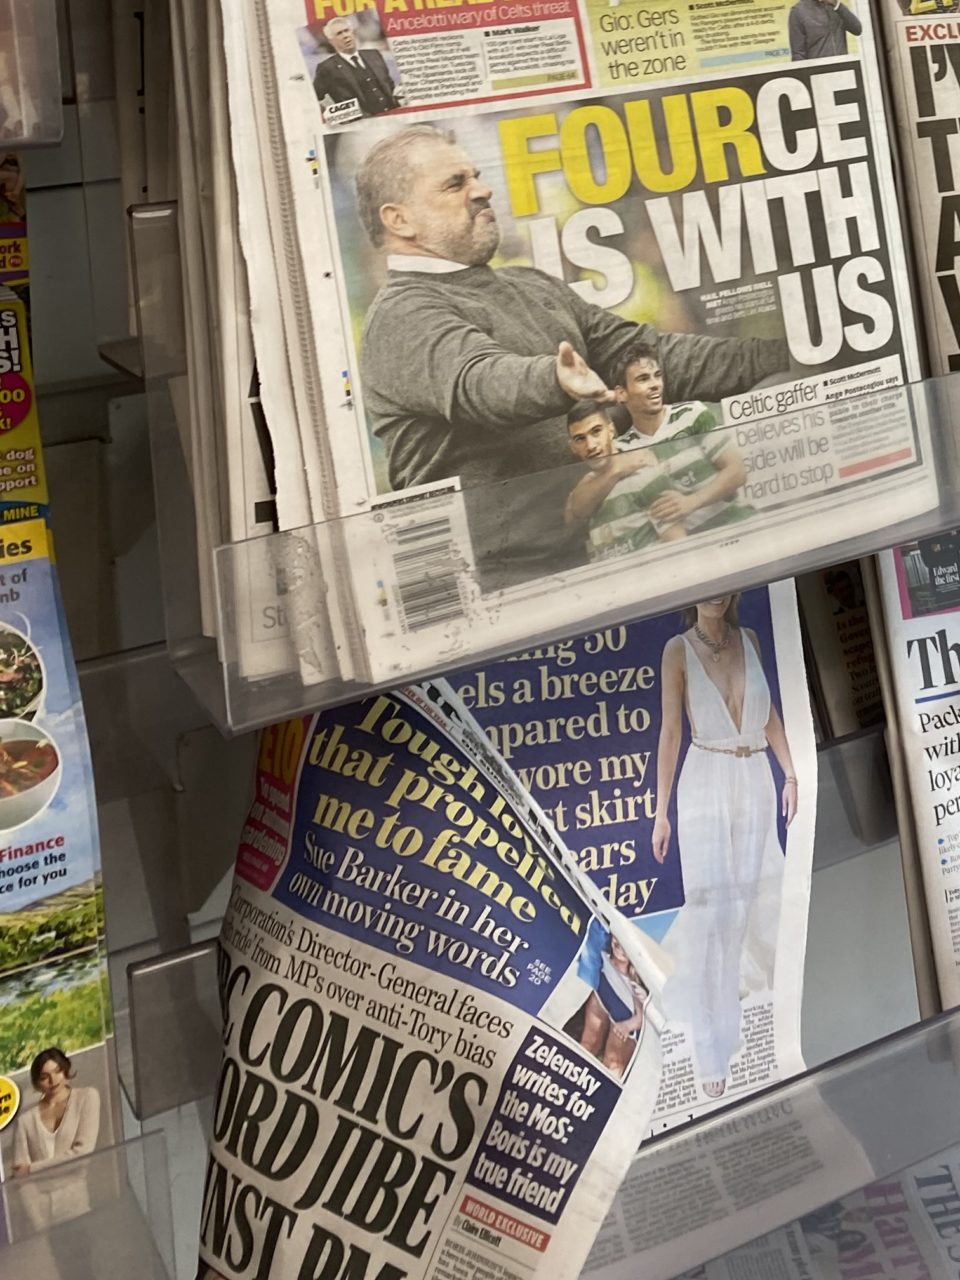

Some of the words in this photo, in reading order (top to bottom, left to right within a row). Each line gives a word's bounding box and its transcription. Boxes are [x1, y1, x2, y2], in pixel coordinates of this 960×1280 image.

[599, 13, 633, 33] Gio:
[637, 8, 680, 26] Gers
[329, 99, 357, 115] CAGEY
[498, 69, 869, 217] FOURCE
[528, 207, 634, 309] IS
[646, 162, 882, 293] WITH
[778, 255, 896, 366] US
[308, 724, 396, 788] that
[385, 768, 589, 938] propelled
[312, 793, 375, 841] me
[374, 807, 424, 858] to
[419, 829, 538, 923] fame
[303, 830, 335, 871] Sue
[336, 846, 438, 910] Barker
[435, 889, 471, 926] in
[469, 903, 531, 956] her
[526, 963, 552, 985] PAGE
[528, 974, 542, 986] 20
[533, 958, 553, 973] SEE
[524, 1034, 602, 1097] Zelensky
[293, 1114, 457, 1260] JIBE
